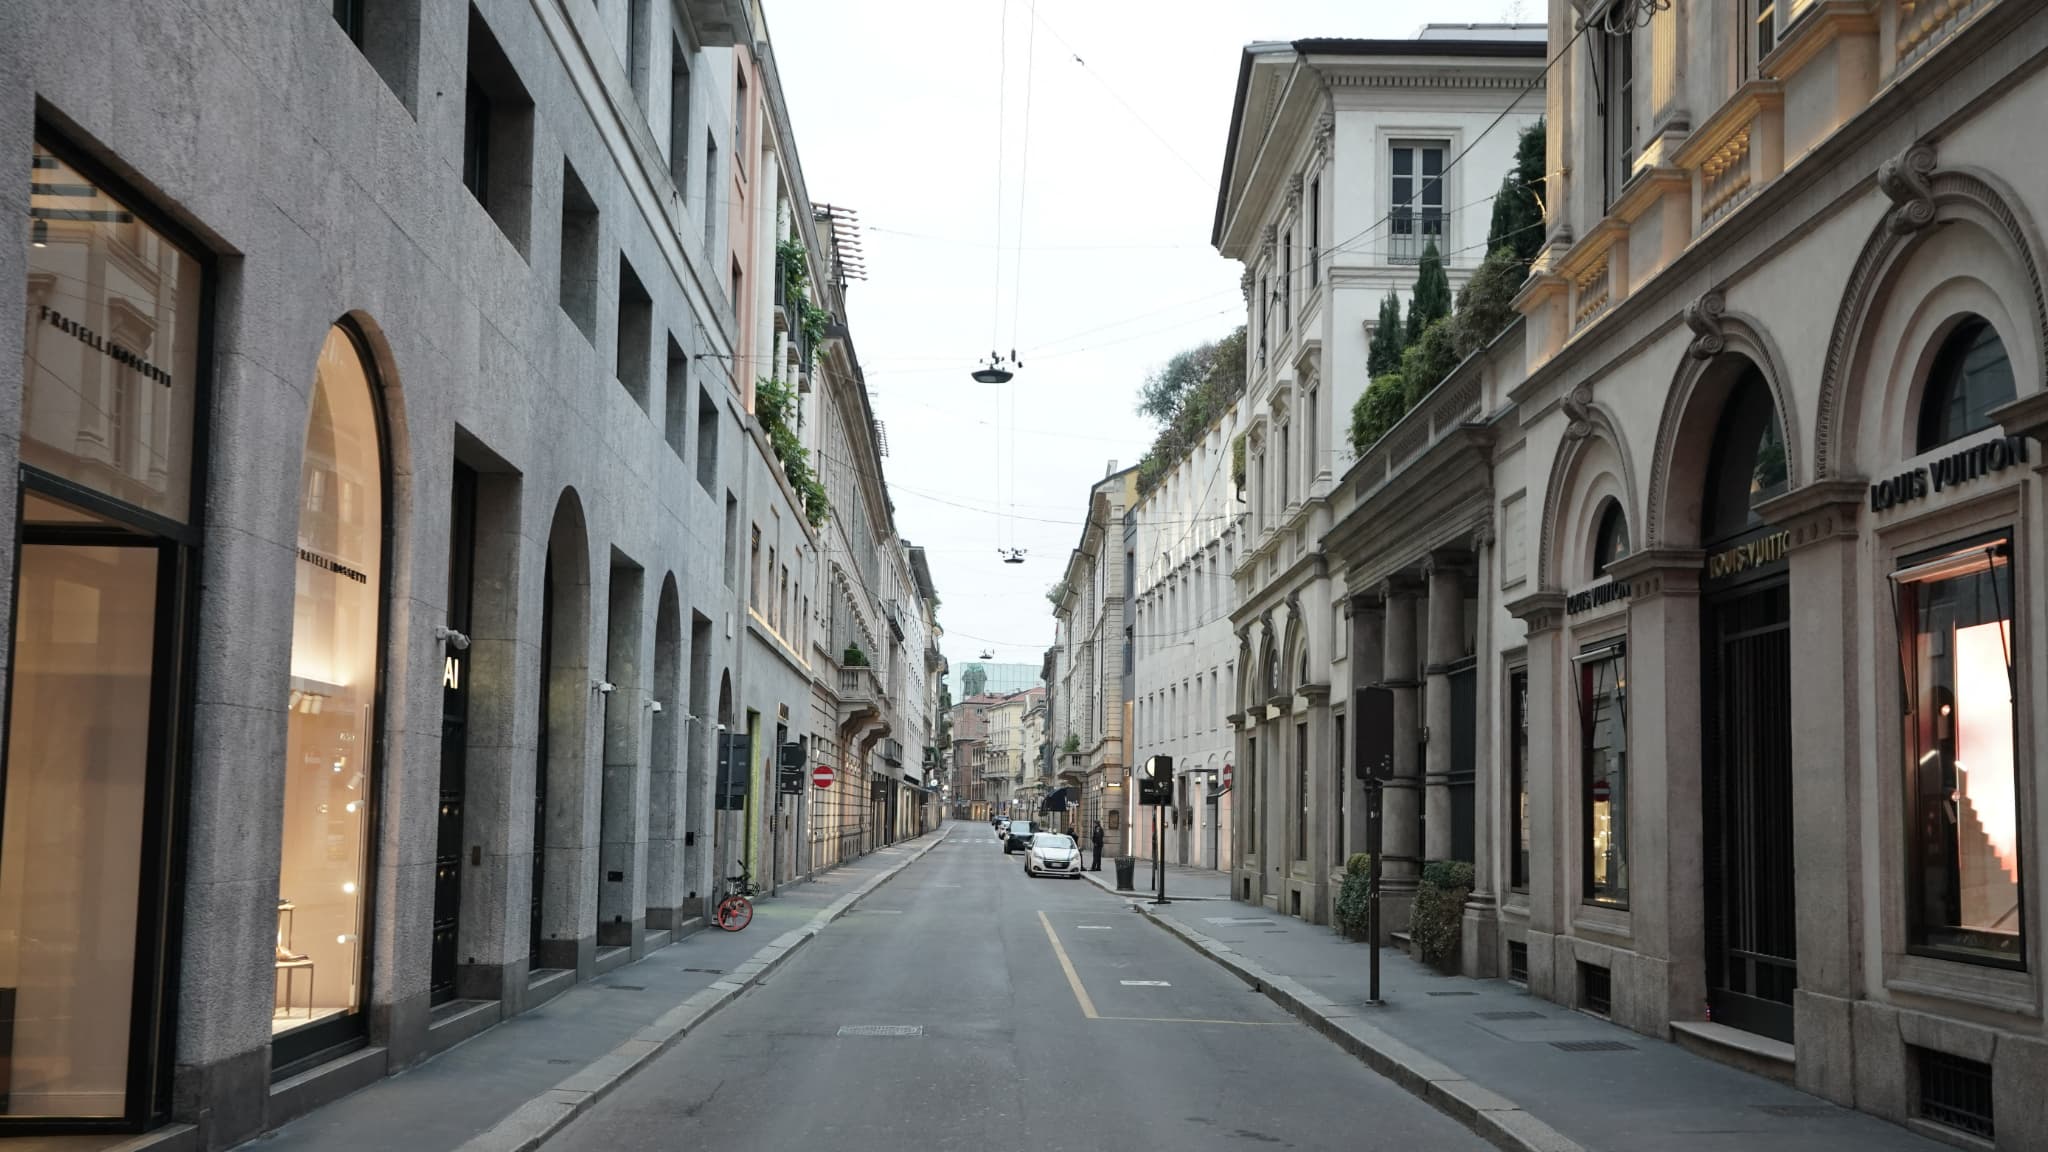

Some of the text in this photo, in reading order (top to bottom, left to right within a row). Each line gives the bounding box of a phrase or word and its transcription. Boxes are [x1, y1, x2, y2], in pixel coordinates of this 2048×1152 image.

[1871, 436, 2027, 513] LOUIS VUITTON
[1710, 546, 1746, 579] LOUIS
